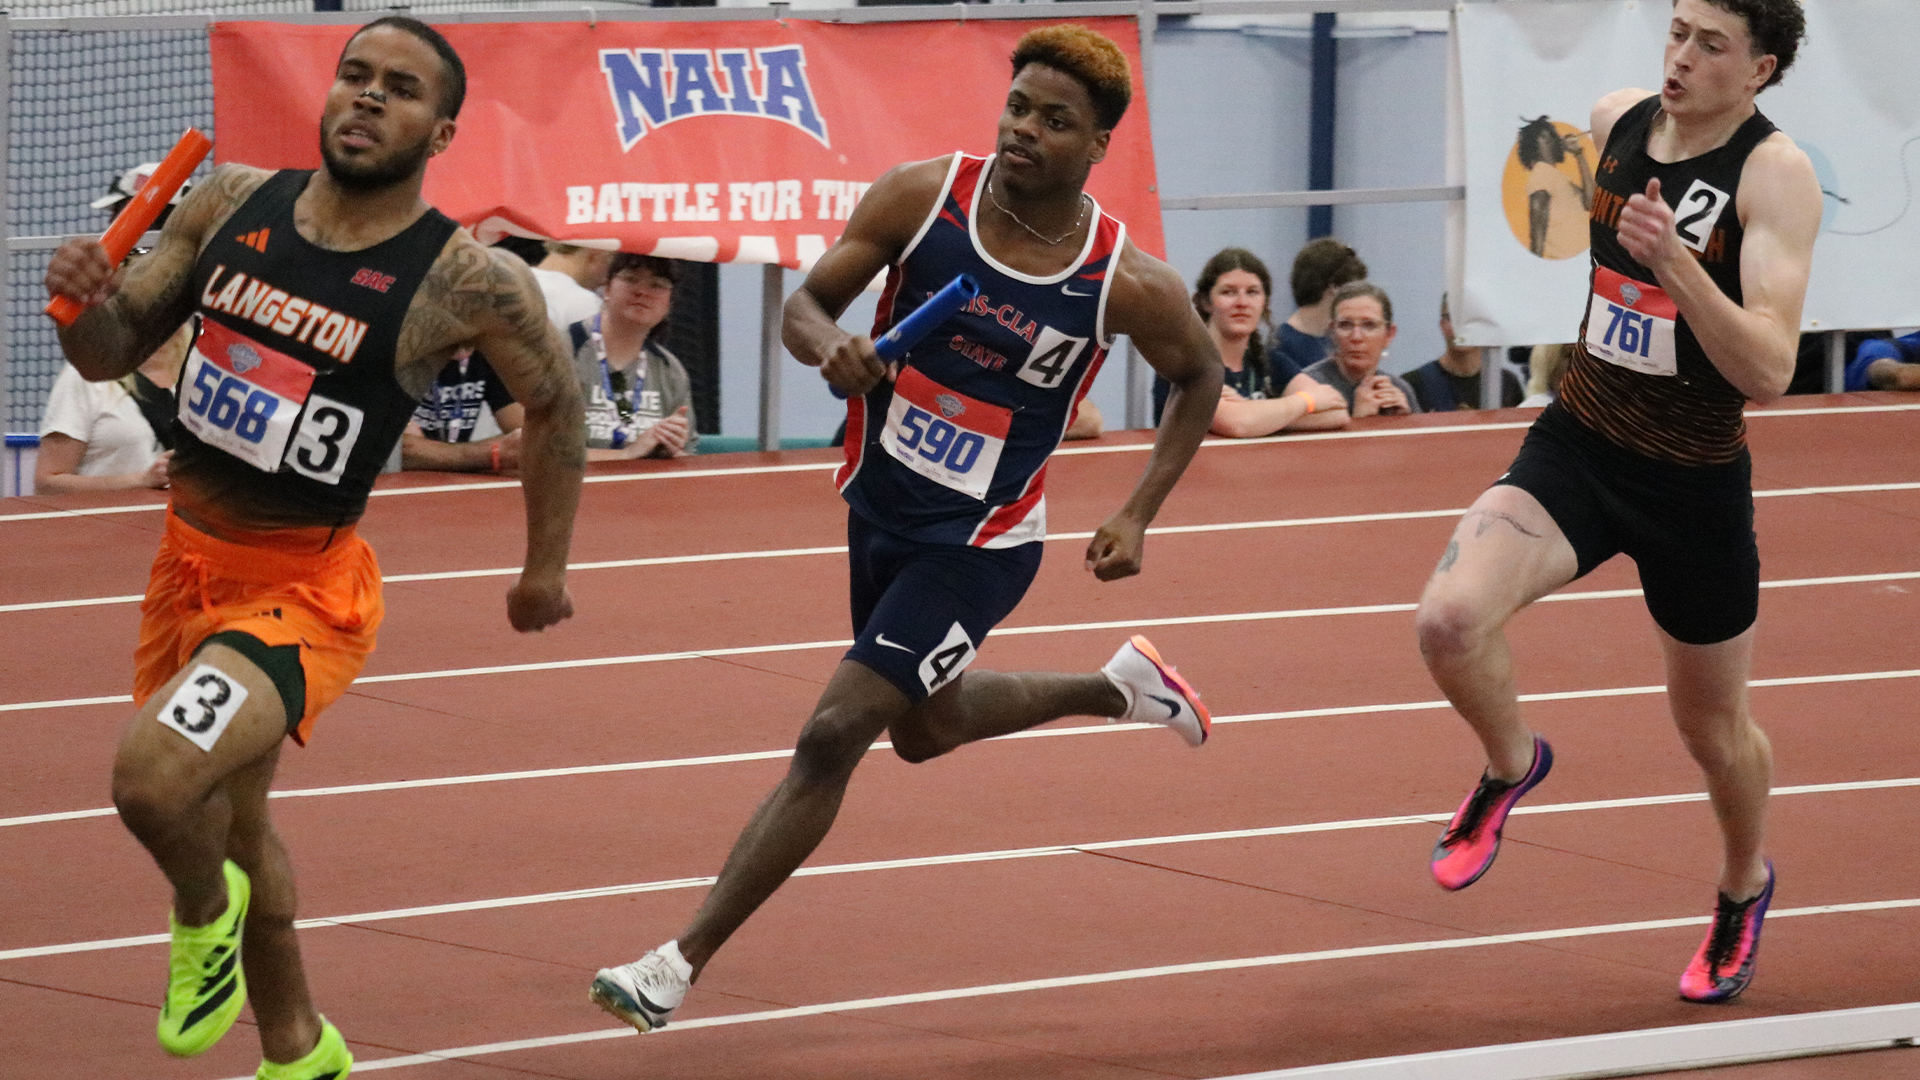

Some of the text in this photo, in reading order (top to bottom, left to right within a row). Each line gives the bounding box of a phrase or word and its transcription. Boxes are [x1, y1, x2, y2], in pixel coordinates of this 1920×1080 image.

[598, 44, 831, 153] NAIA
[566, 182, 720, 225] BATTLE
[728, 179, 802, 221] FOR
[1676, 188, 1717, 246] 2
[350, 267, 396, 293] SAC
[201, 264, 369, 364] LANGSTON
[1602, 303, 1654, 358] 761
[949, 335, 1008, 372] STATE
[1029, 339, 1078, 384] 4
[188, 360, 280, 444] 568
[297, 406, 350, 474] 3
[896, 404, 986, 475] 590
[929, 641, 970, 690] 4
[173, 673, 232, 734] 3
